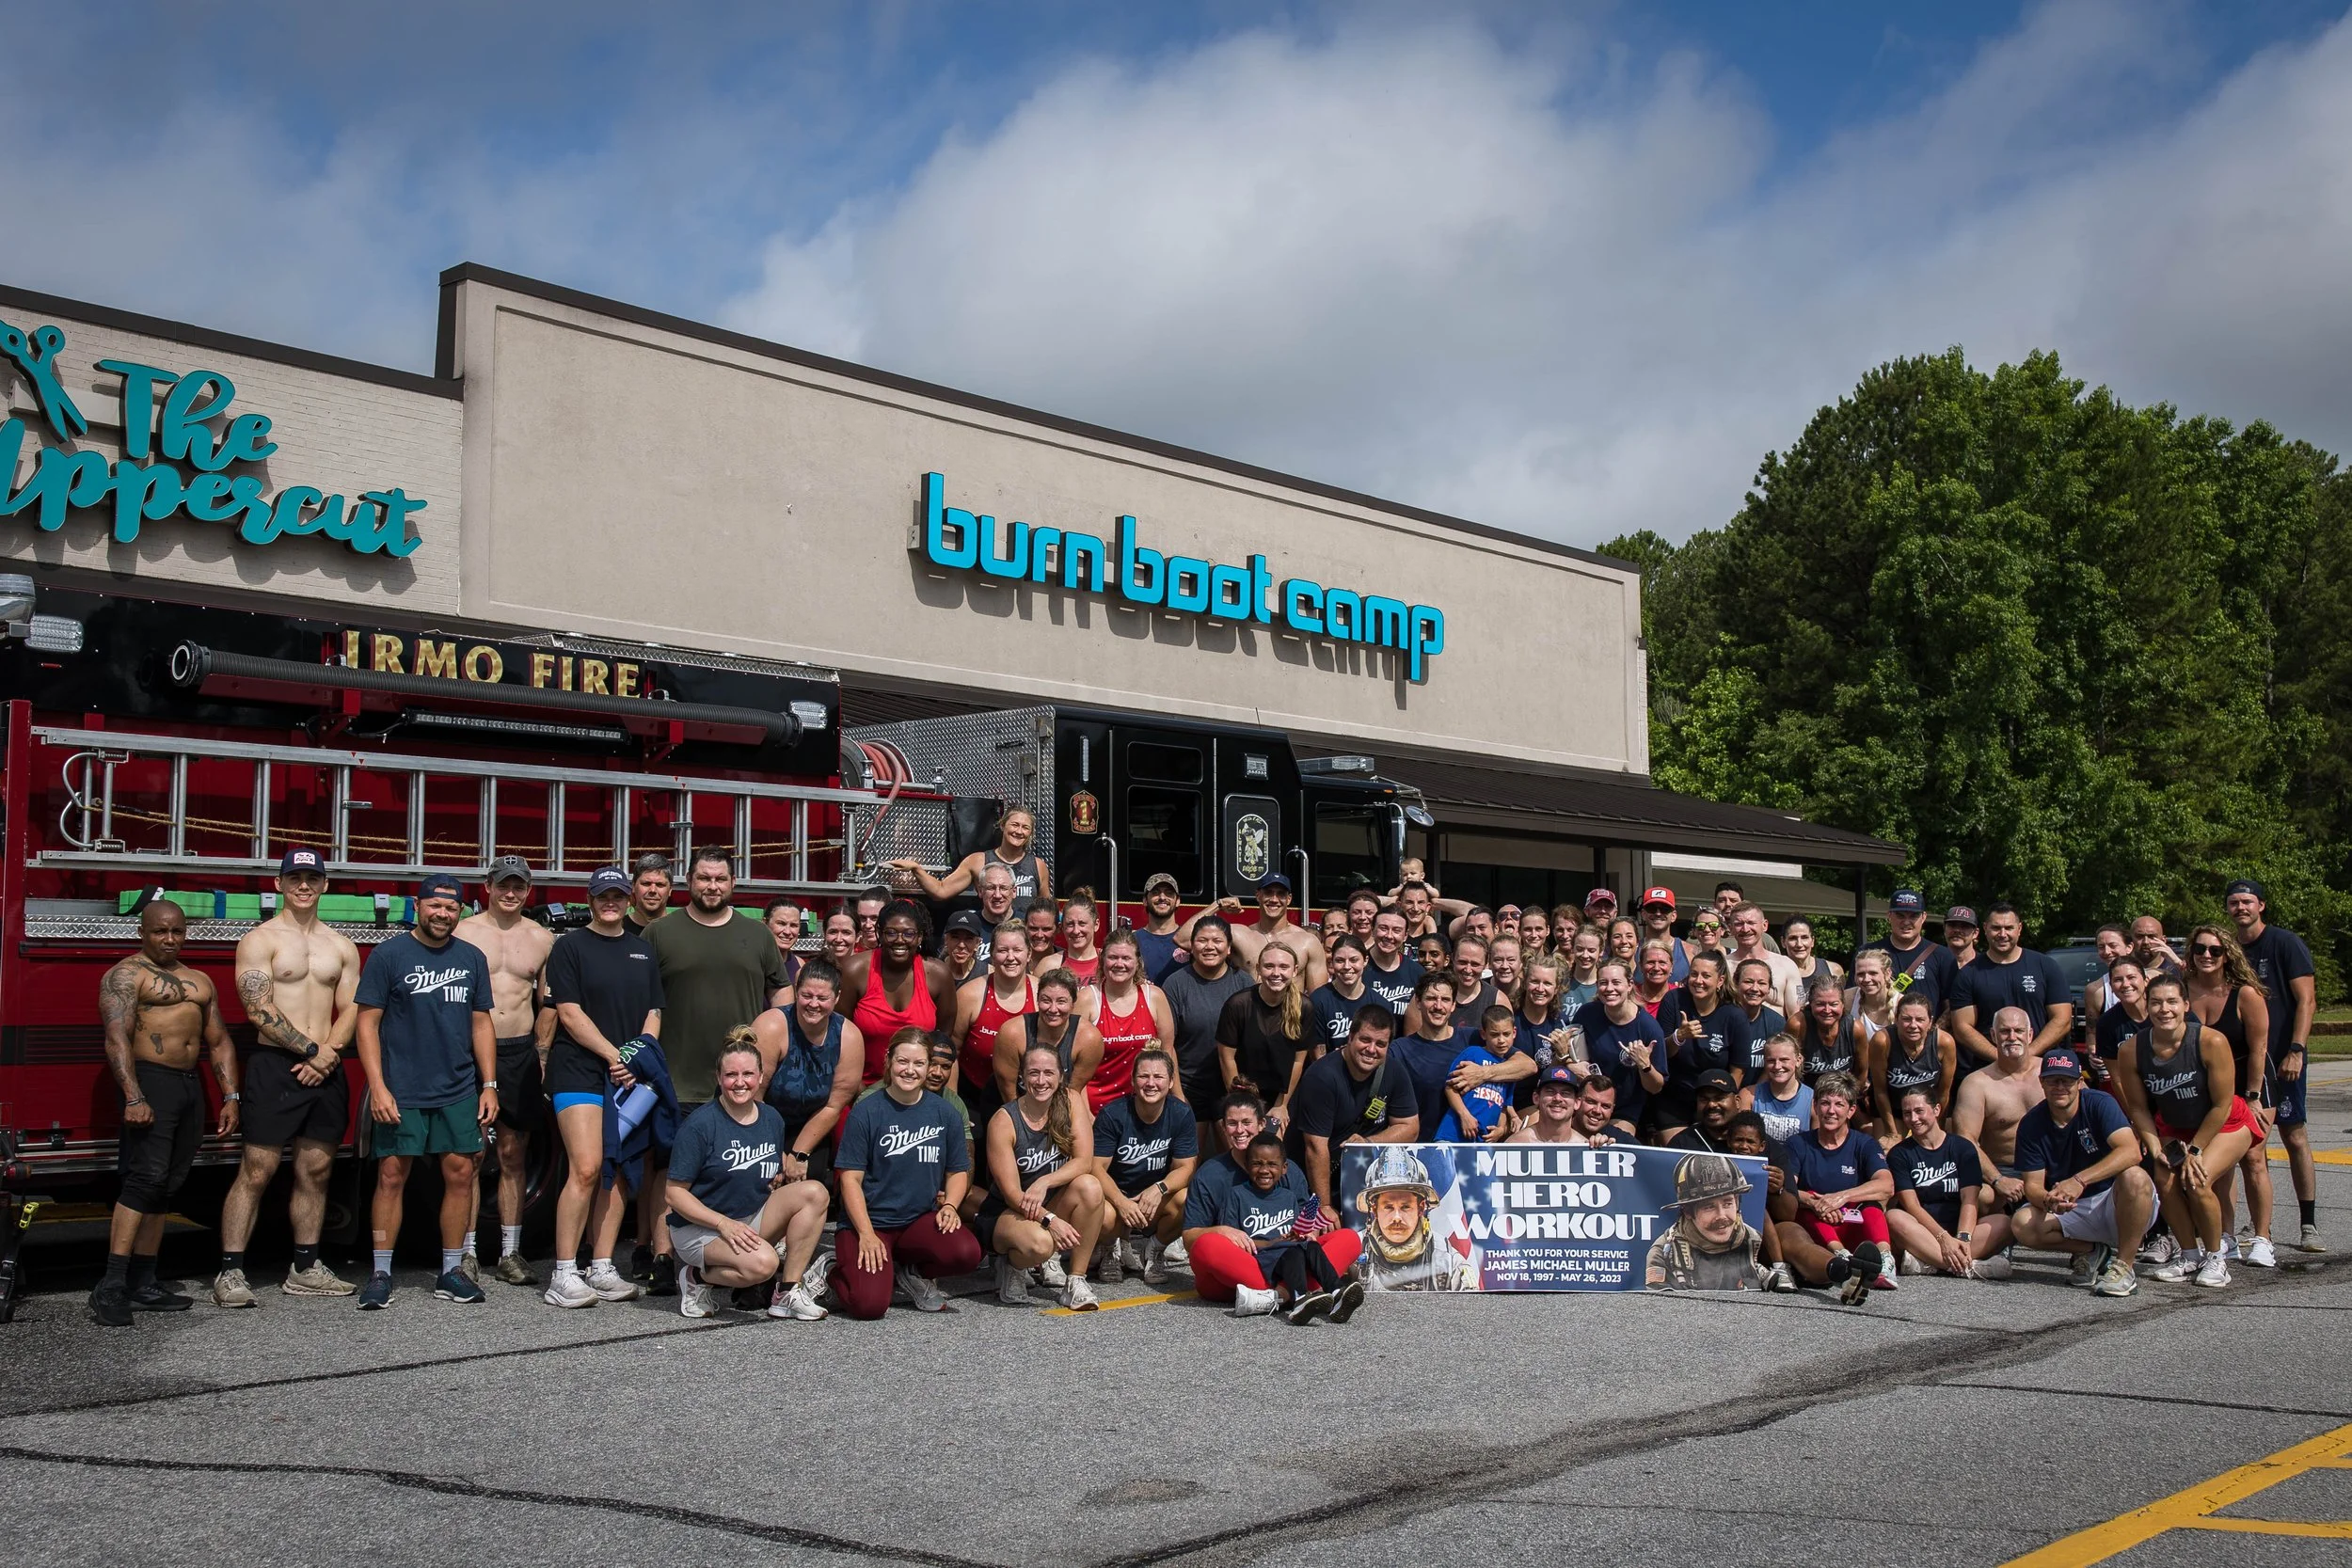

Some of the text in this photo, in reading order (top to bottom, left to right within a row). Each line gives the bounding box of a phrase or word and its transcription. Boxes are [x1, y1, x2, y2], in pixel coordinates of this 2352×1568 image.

[97, 359, 278, 470] The
[923, 472, 1444, 681] burn boot camp
[342, 630, 641, 698] IRMO FIRE
[1080, 801, 1089, 825] 1
[1016, 886, 1033, 897] TIME
[404, 968, 470, 992] Muller
[443, 986, 469, 1003] TIME
[1393, 1001, 1410, 1015] TIM
[1118, 1034, 1135, 1042] boot
[1751, 1054, 1765, 1068] TIM
[1803, 1055, 1853, 1072] Muller
[1887, 1070, 1939, 1086] Muller
[2145, 1071, 2197, 1093] Muller
[2173, 1086, 2199, 1100] TIME
[879, 1125, 945, 1153] Muller
[1117, 1137, 1172, 1162] Muller
[722, 1142, 776, 1168] Mulle
[916, 1146, 941, 1163] TIME
[1016, 1143, 1060, 1172] Mull
[1476, 1150, 1636, 1177] MULLER
[1911, 1161, 1957, 1185] Mulle
[1491, 1181, 1612, 1208] HERO
[1942, 1179, 1959, 1192] TIM
[1243, 1209, 1295, 1233] Mulle
[1277, 1225, 1292, 1235] TI
[1447, 1212, 1660, 1241] WORKOUT
[1486, 1248, 1629, 1259] THANK YOU FOR YOUR SERVICE
[1485, 1259, 1629, 1272] JAMES MICHAEL MULLER
[1497, 1273, 1518, 1281] NOV
[1519, 1273, 1532, 1284] 18,
[1533, 1273, 1554, 1281] 1997
[1561, 1273, 1581, 1282] MAY
[1582, 1273, 1598, 1284] 26,
[1599, 1274, 1622, 1283] 2023
